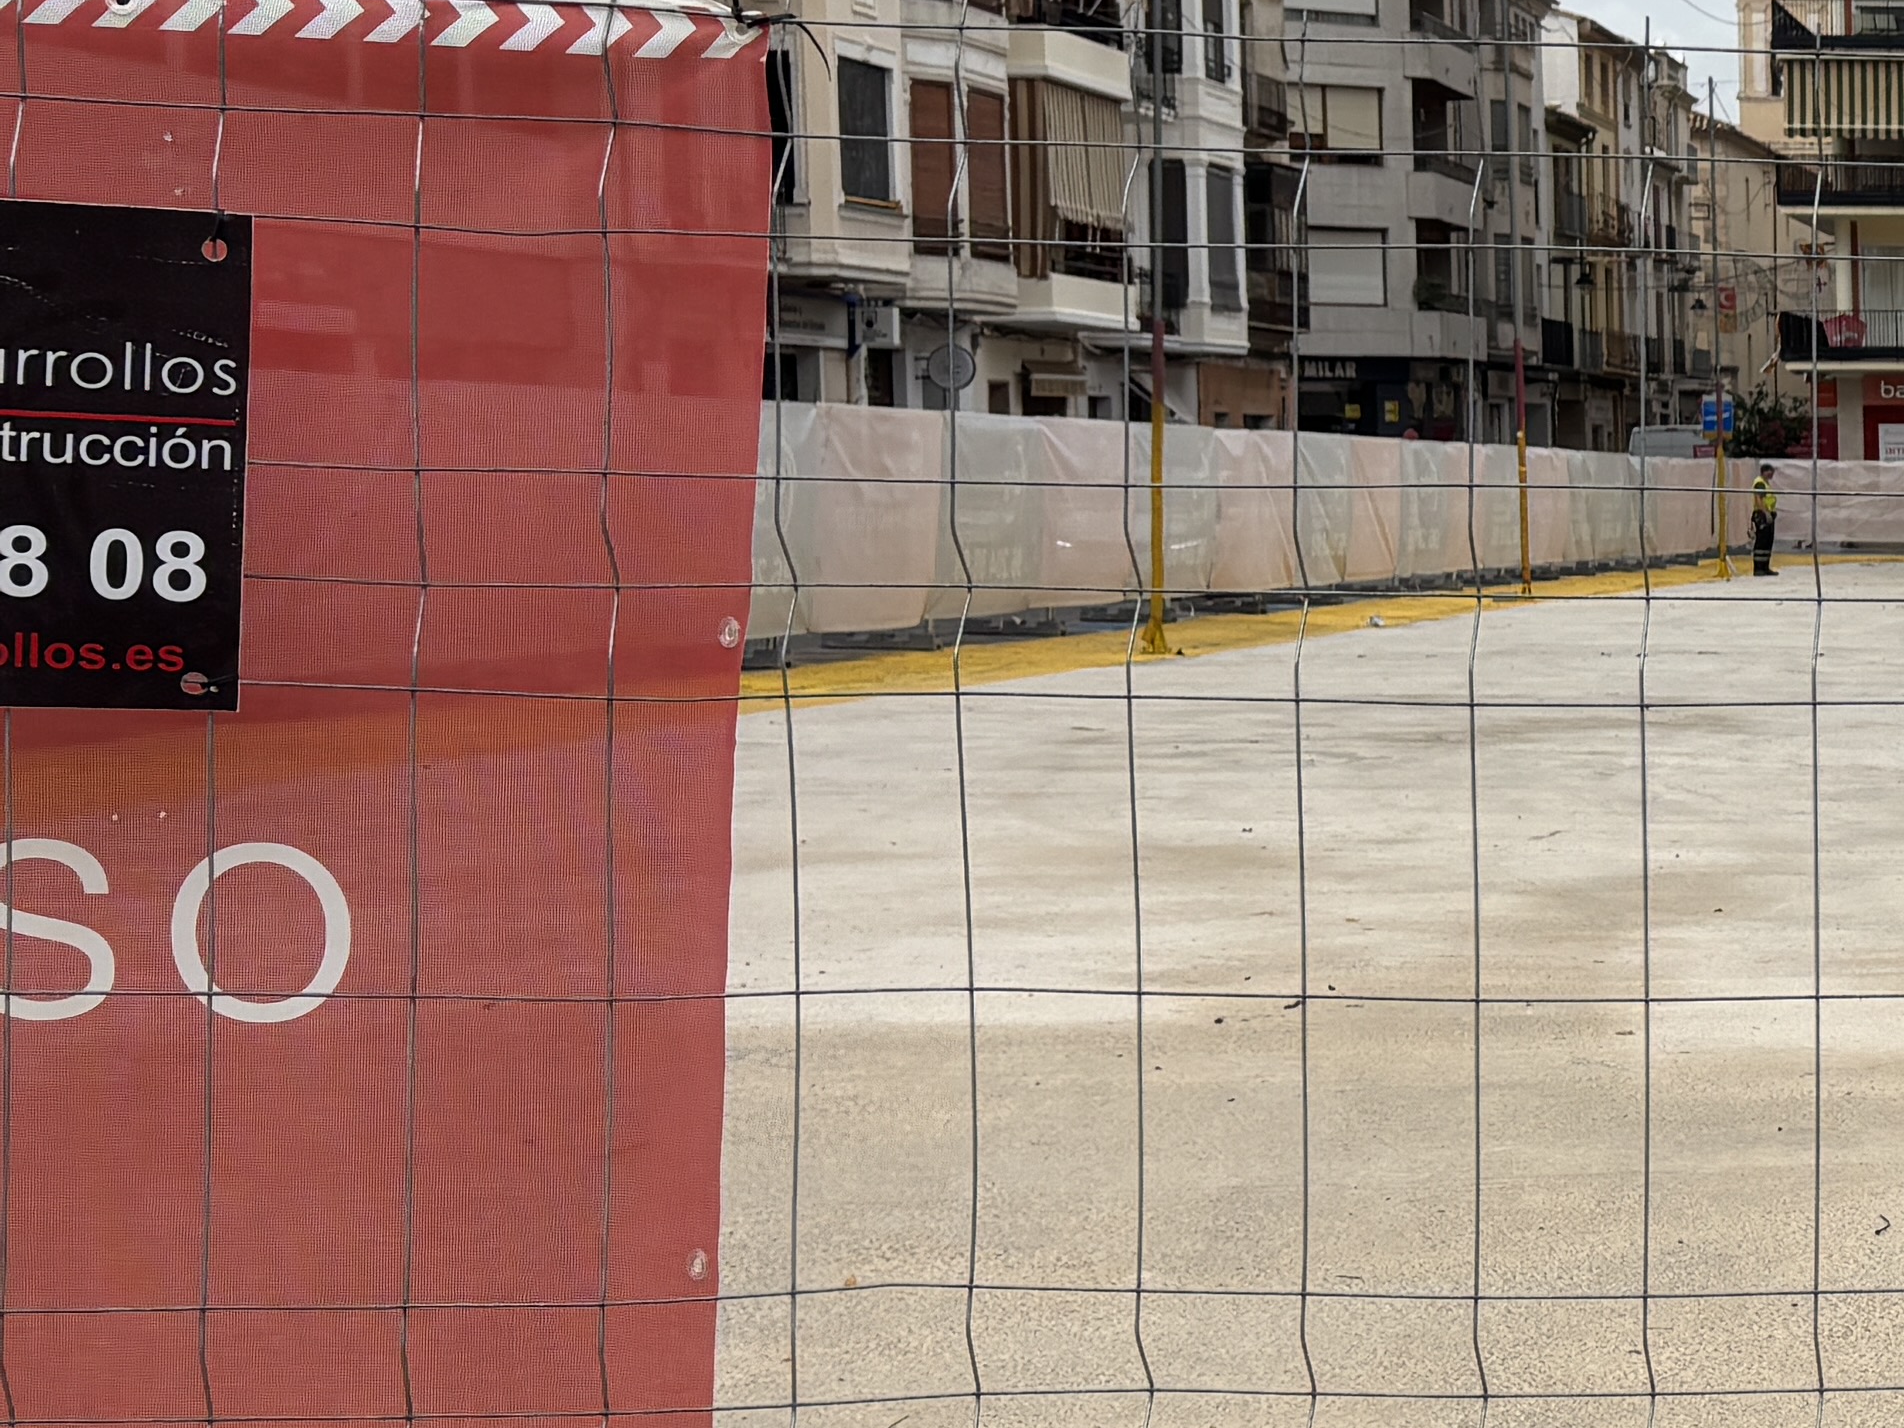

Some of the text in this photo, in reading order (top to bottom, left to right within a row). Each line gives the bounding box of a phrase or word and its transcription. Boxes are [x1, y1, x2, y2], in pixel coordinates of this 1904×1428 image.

[0, 342, 237, 396] rrollos
[1303, 360, 1357, 378] MILAR
[88, 528, 208, 602] 08
[0, 632, 185, 672] llos.es
[0, 837, 352, 1024] SO
